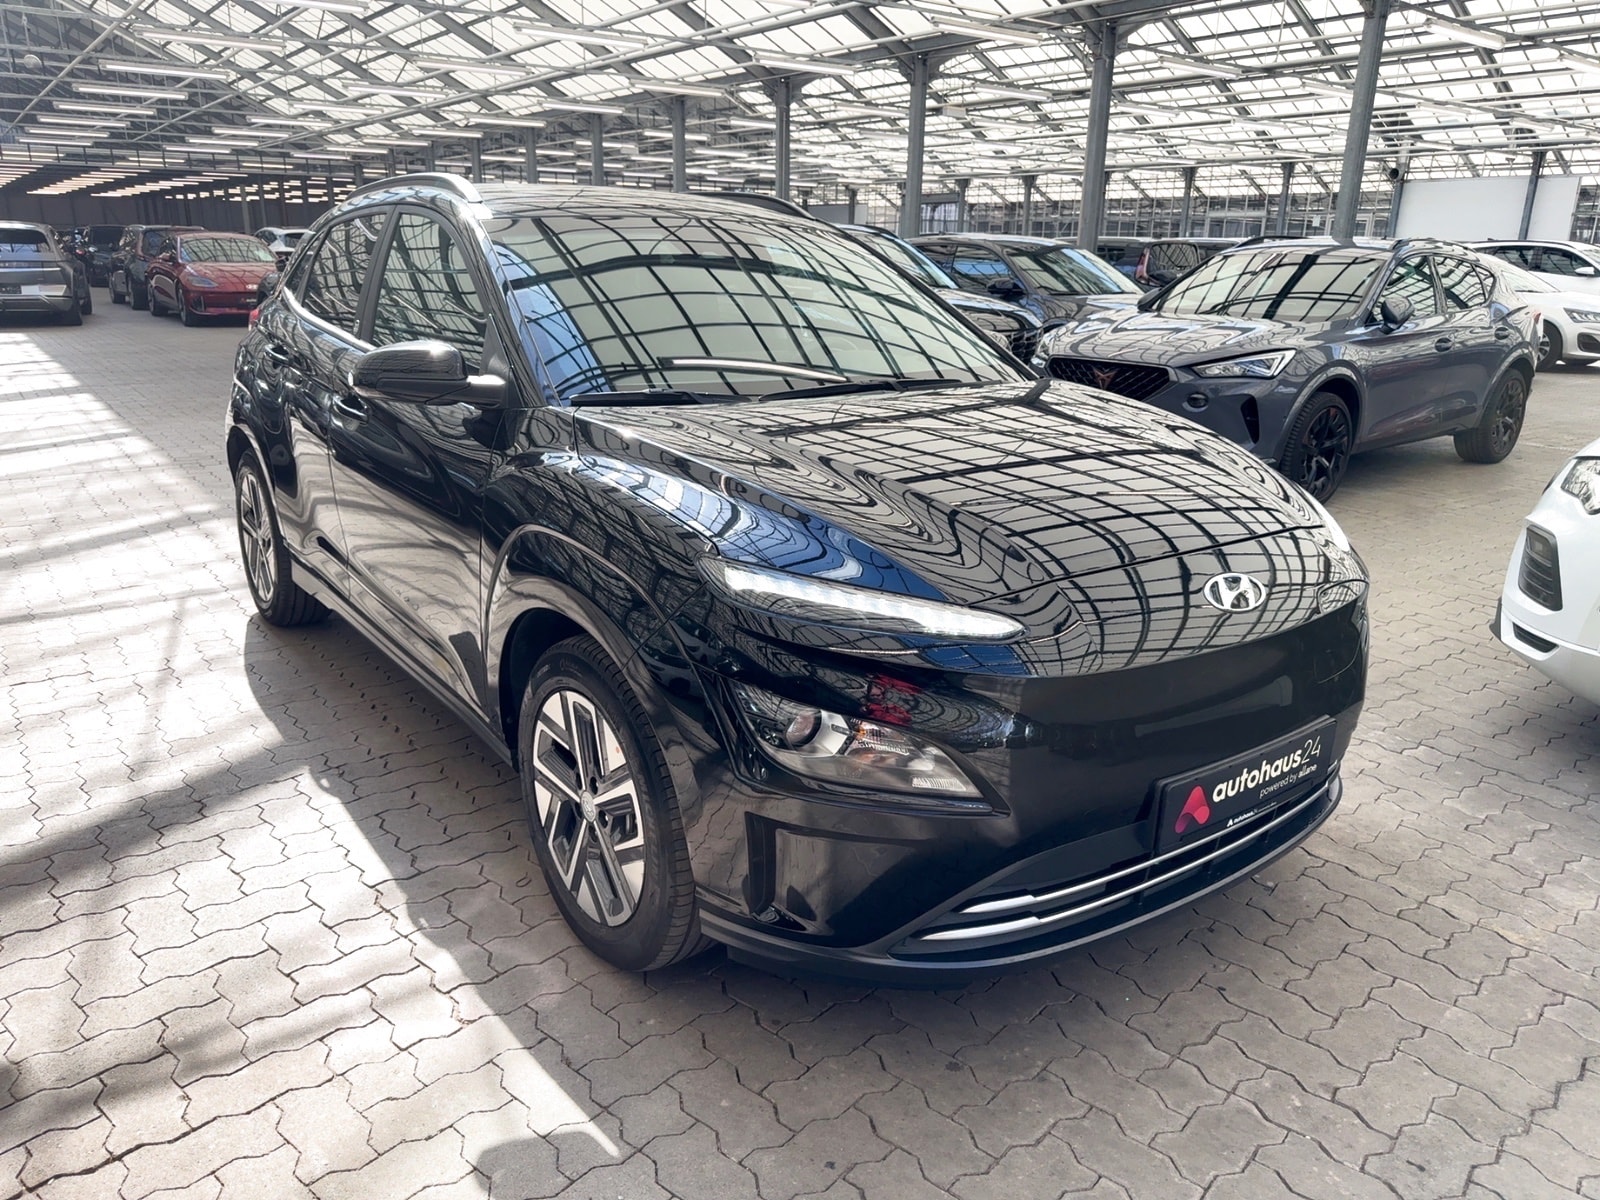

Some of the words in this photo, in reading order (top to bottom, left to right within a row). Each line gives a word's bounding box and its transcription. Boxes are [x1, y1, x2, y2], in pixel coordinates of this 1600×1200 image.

[1212, 736, 1321, 802] autohaus24
[1259, 775, 1289, 799] powered
[1290, 772, 1298, 783] by
